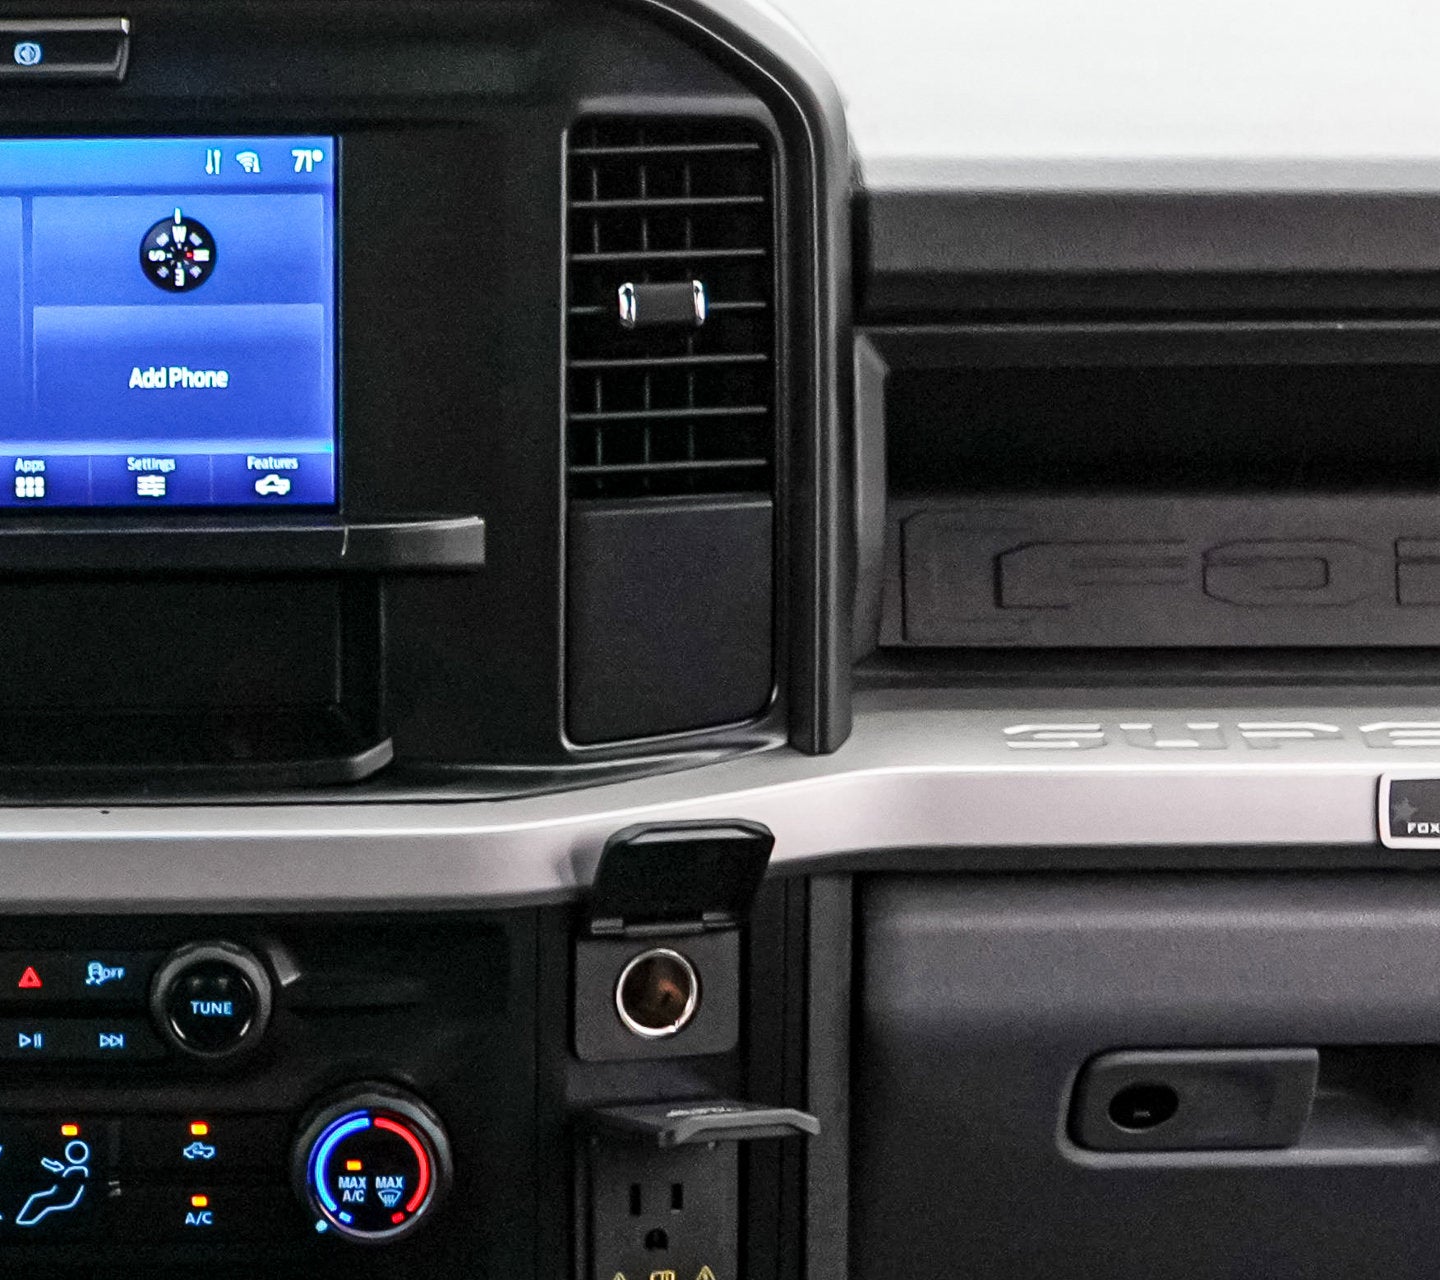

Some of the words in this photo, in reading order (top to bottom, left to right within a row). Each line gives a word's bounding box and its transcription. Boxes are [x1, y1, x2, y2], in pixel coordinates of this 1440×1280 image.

[171, 225, 188, 244] W
[147, 248, 167, 263] S
[174, 268, 185, 287] E
[128, 366, 167, 389] Add
[168, 366, 229, 389] Phone
[15, 456, 46, 474] Apps
[127, 455, 176, 474] Settings
[246, 454, 299, 471] Features
[1406, 822, 1440, 835] FOX
[190, 1000, 233, 1016] TUNE
[338, 1176, 367, 1189] MAX
[375, 1176, 404, 1189] MAX
[342, 1189, 366, 1203] A/C
[184, 1211, 213, 1226] A/C
